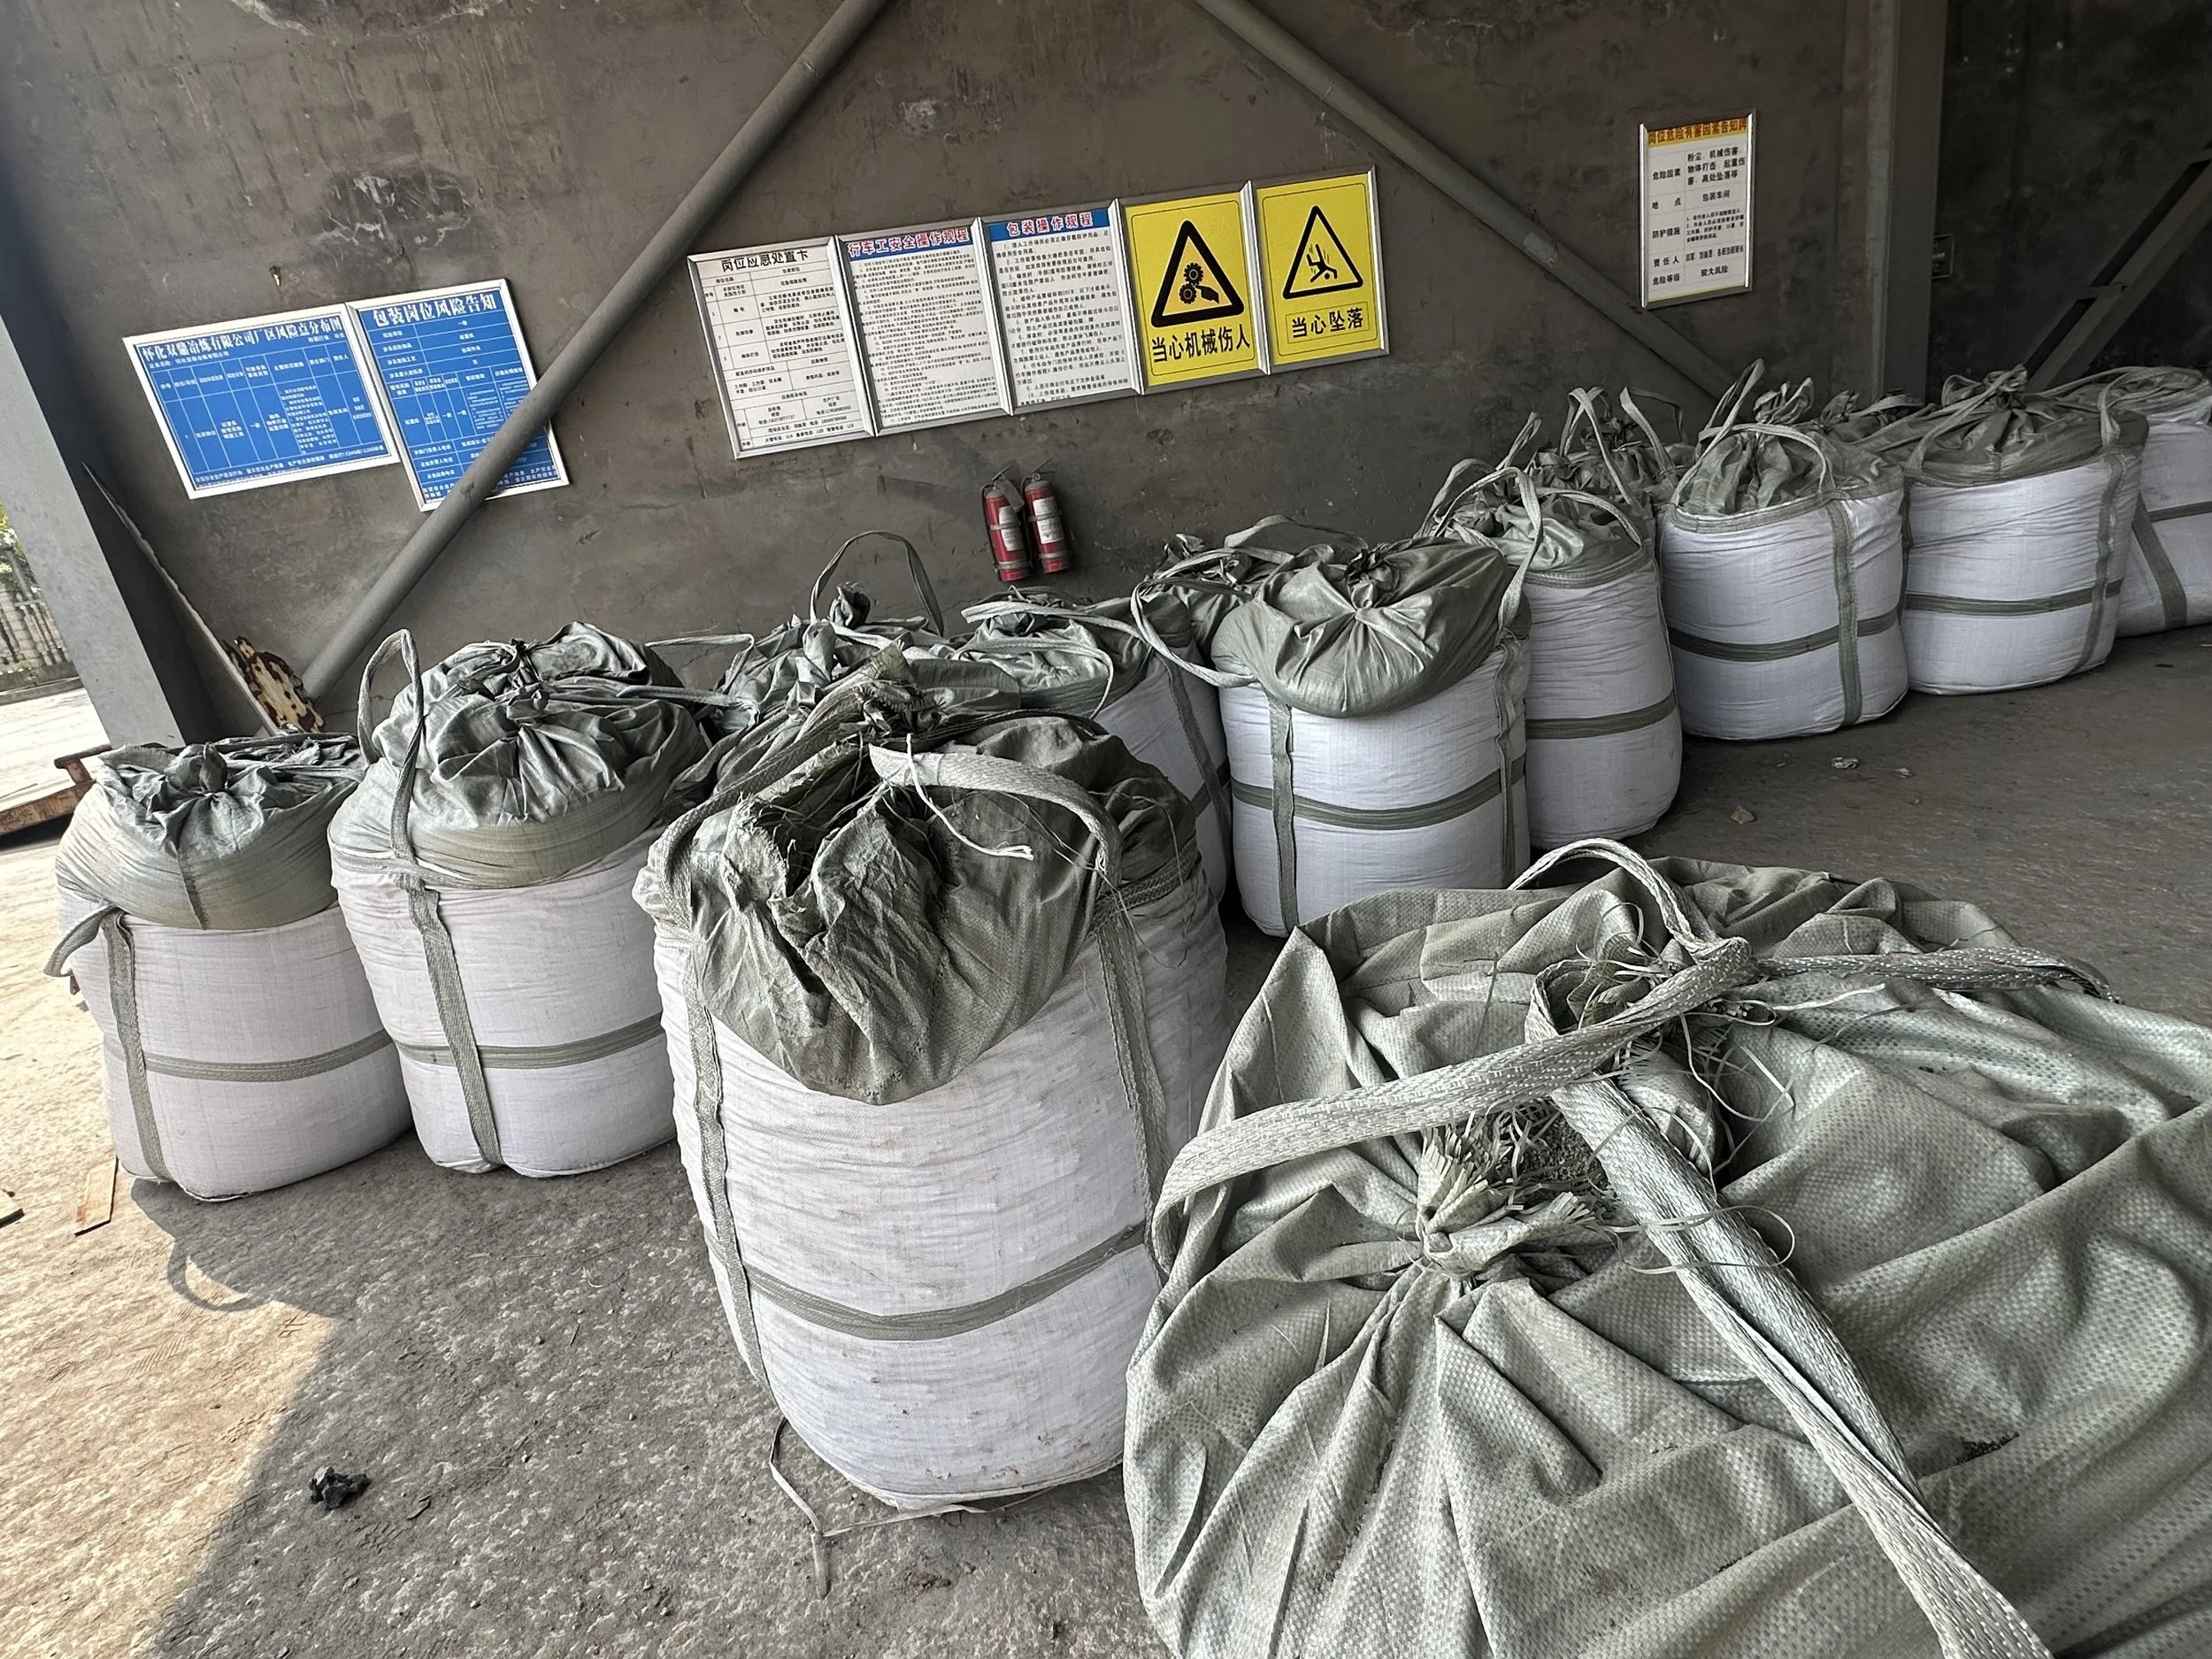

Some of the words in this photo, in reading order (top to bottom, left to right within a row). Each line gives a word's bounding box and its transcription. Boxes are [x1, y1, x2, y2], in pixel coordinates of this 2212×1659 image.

[1006, 211, 1093, 238] 包装操作规程
[847, 228, 970, 257] 行车工安全操作规程
[720, 250, 810, 272] 岗位应急处置卡
[371, 295, 497, 326] 包装岗位风险告知
[1292, 307, 1363, 338] 当心坠落
[1152, 324, 1250, 362] 当心机械伤人
